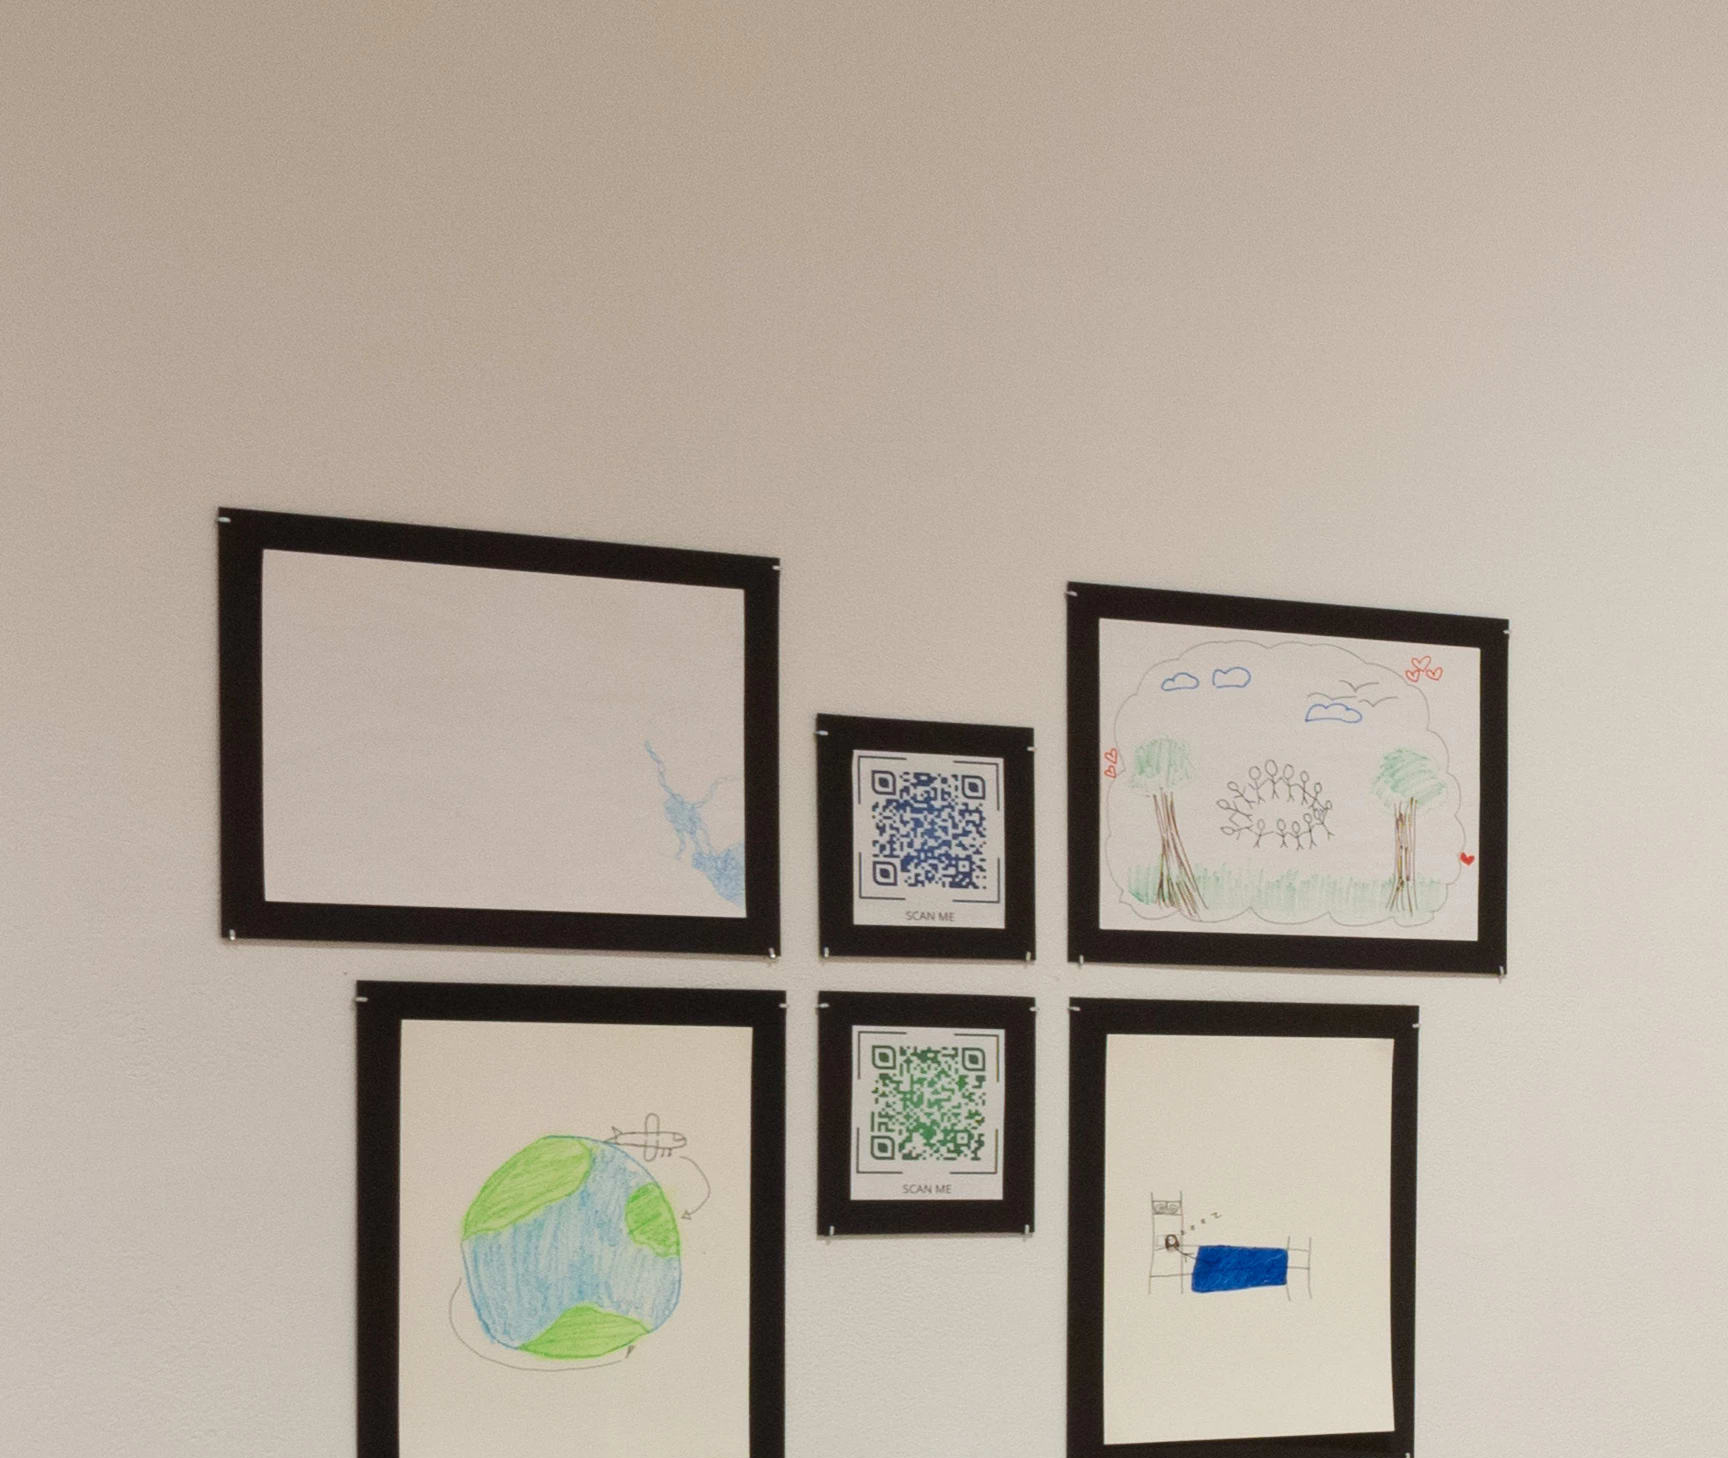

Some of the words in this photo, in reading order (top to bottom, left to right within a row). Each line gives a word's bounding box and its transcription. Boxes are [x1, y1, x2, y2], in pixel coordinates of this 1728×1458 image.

[905, 911, 935, 921] SCAN
[938, 912, 956, 921] ME
[902, 1184, 932, 1194] SCAN
[935, 1184, 952, 1194] ME
